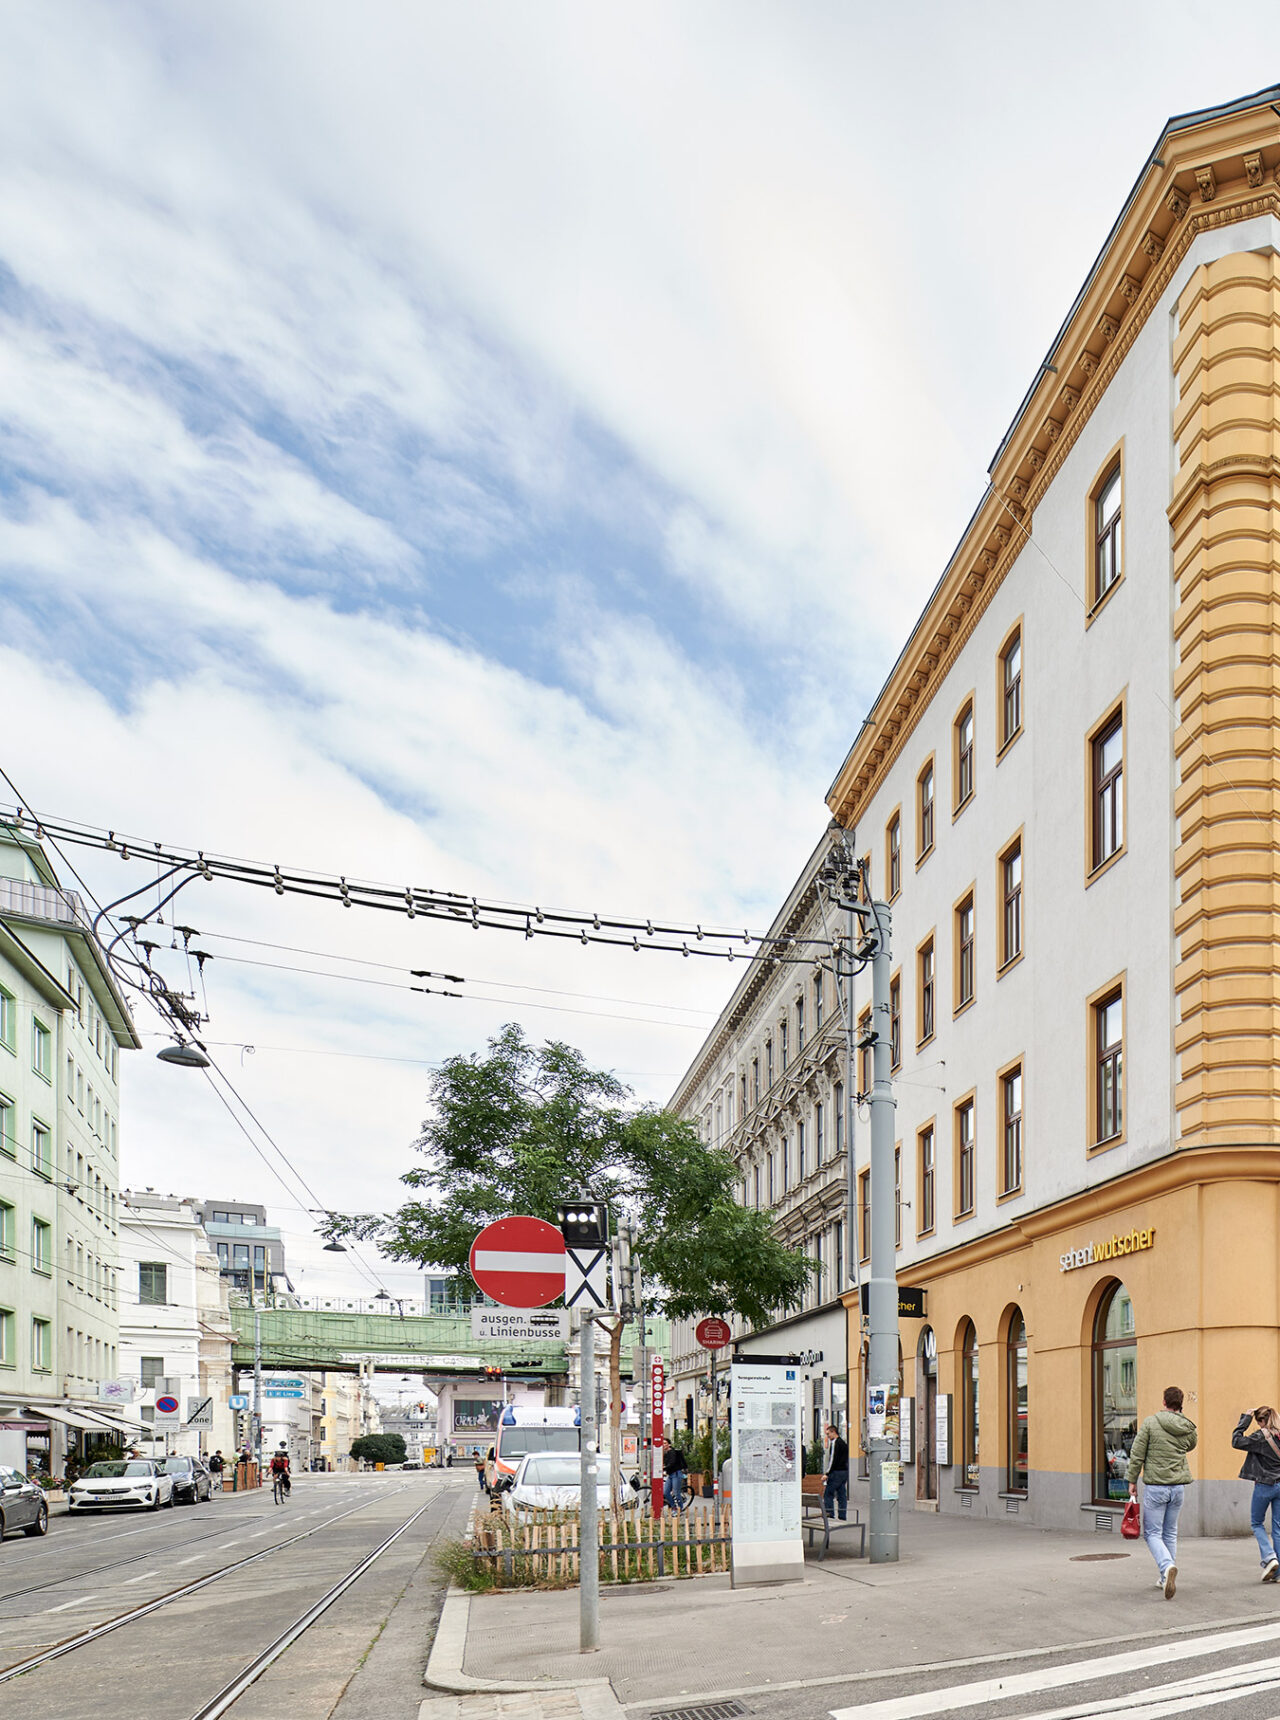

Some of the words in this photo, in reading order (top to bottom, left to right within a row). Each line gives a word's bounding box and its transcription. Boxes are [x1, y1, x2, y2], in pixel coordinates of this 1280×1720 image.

[898, 1302, 916, 1311] cher
[481, 1315, 527, 1325] ausgen.
[490, 1326, 561, 1338] Linienbusse
